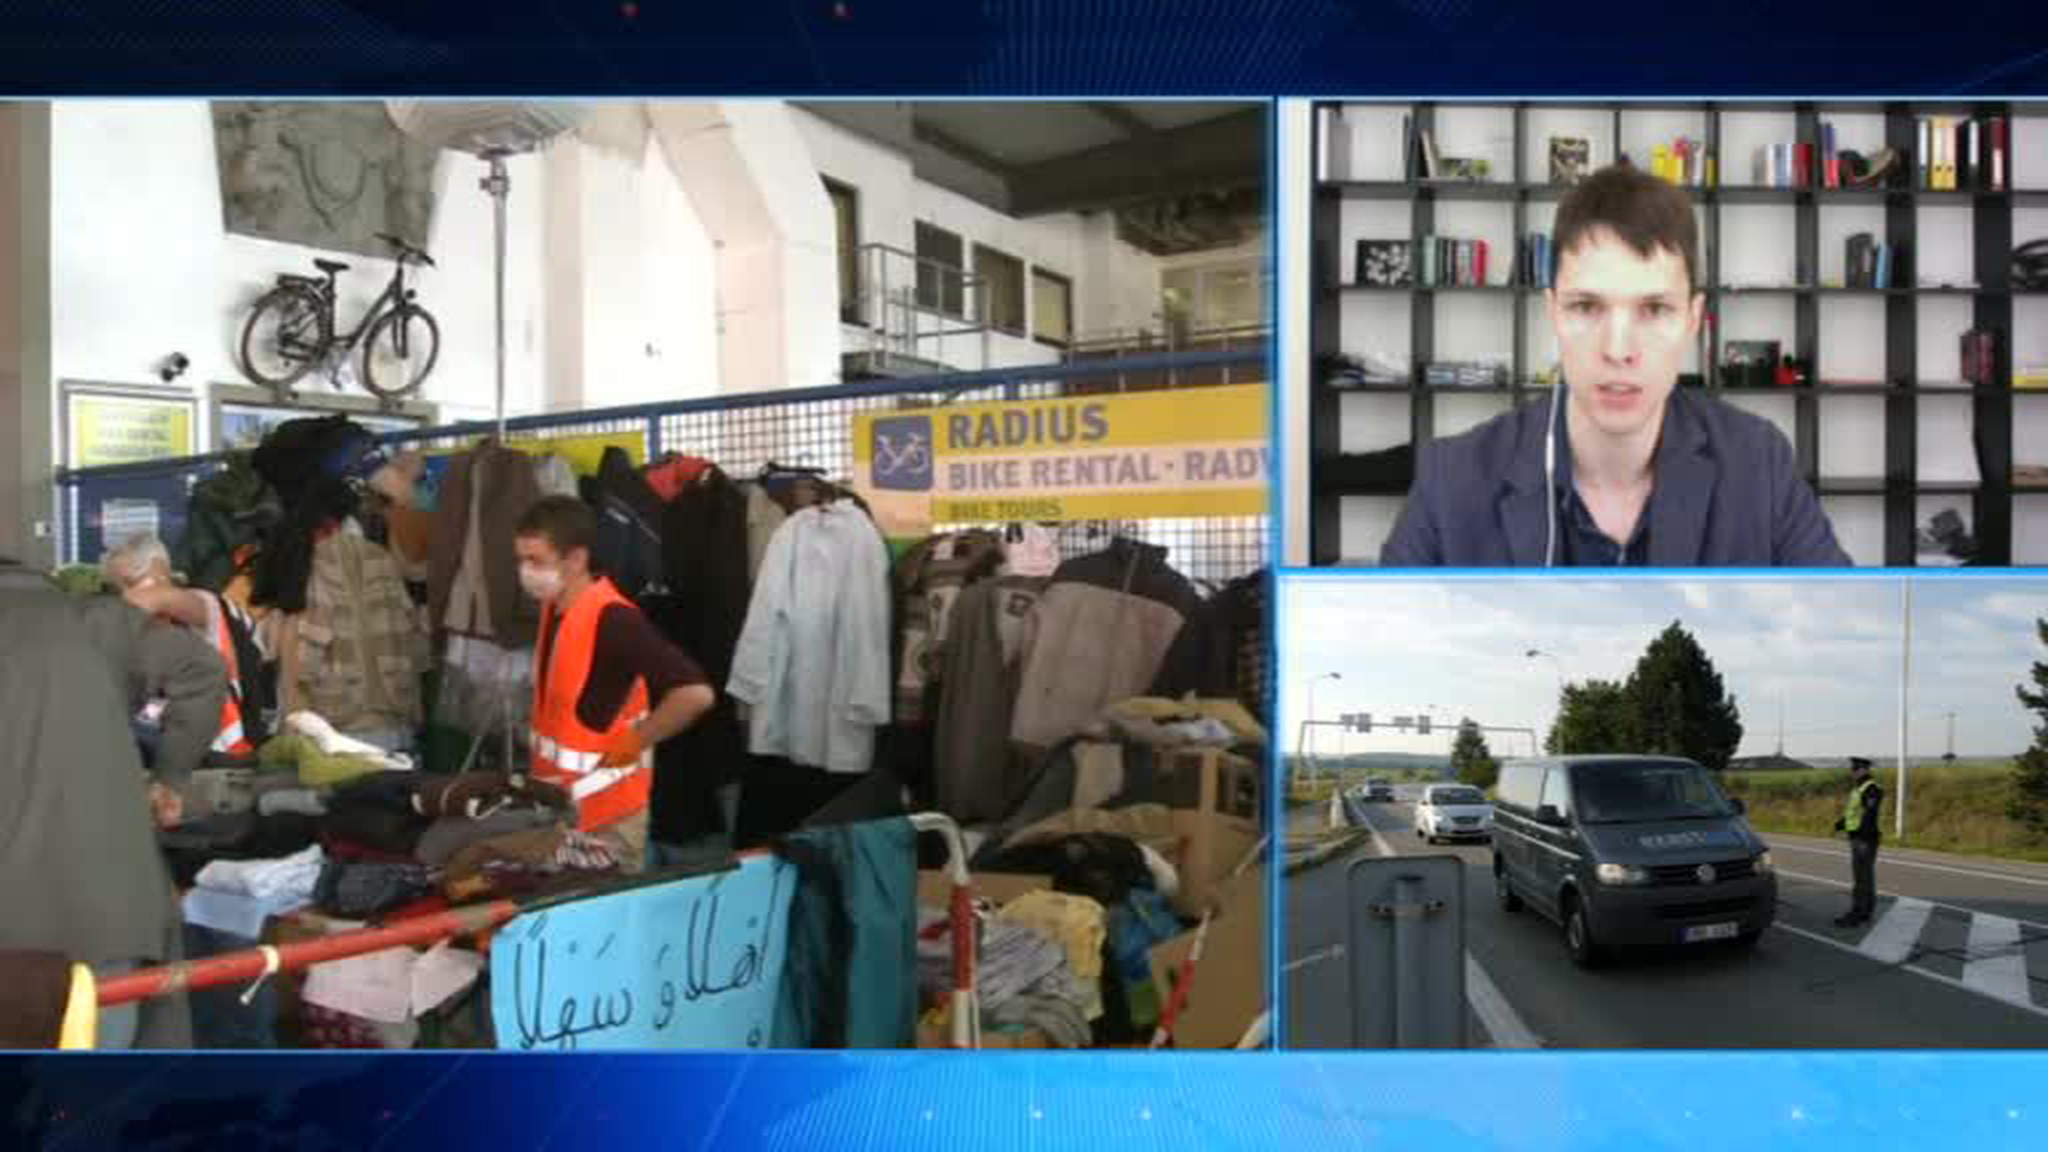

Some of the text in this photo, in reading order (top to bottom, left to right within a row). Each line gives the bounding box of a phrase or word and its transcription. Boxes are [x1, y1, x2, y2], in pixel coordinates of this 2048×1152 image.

[948, 404, 1109, 448] RADIUS
[949, 461, 1020, 491] BIKE
[1030, 456, 1158, 487] RENTAL
[949, 502, 991, 520] BIKE
